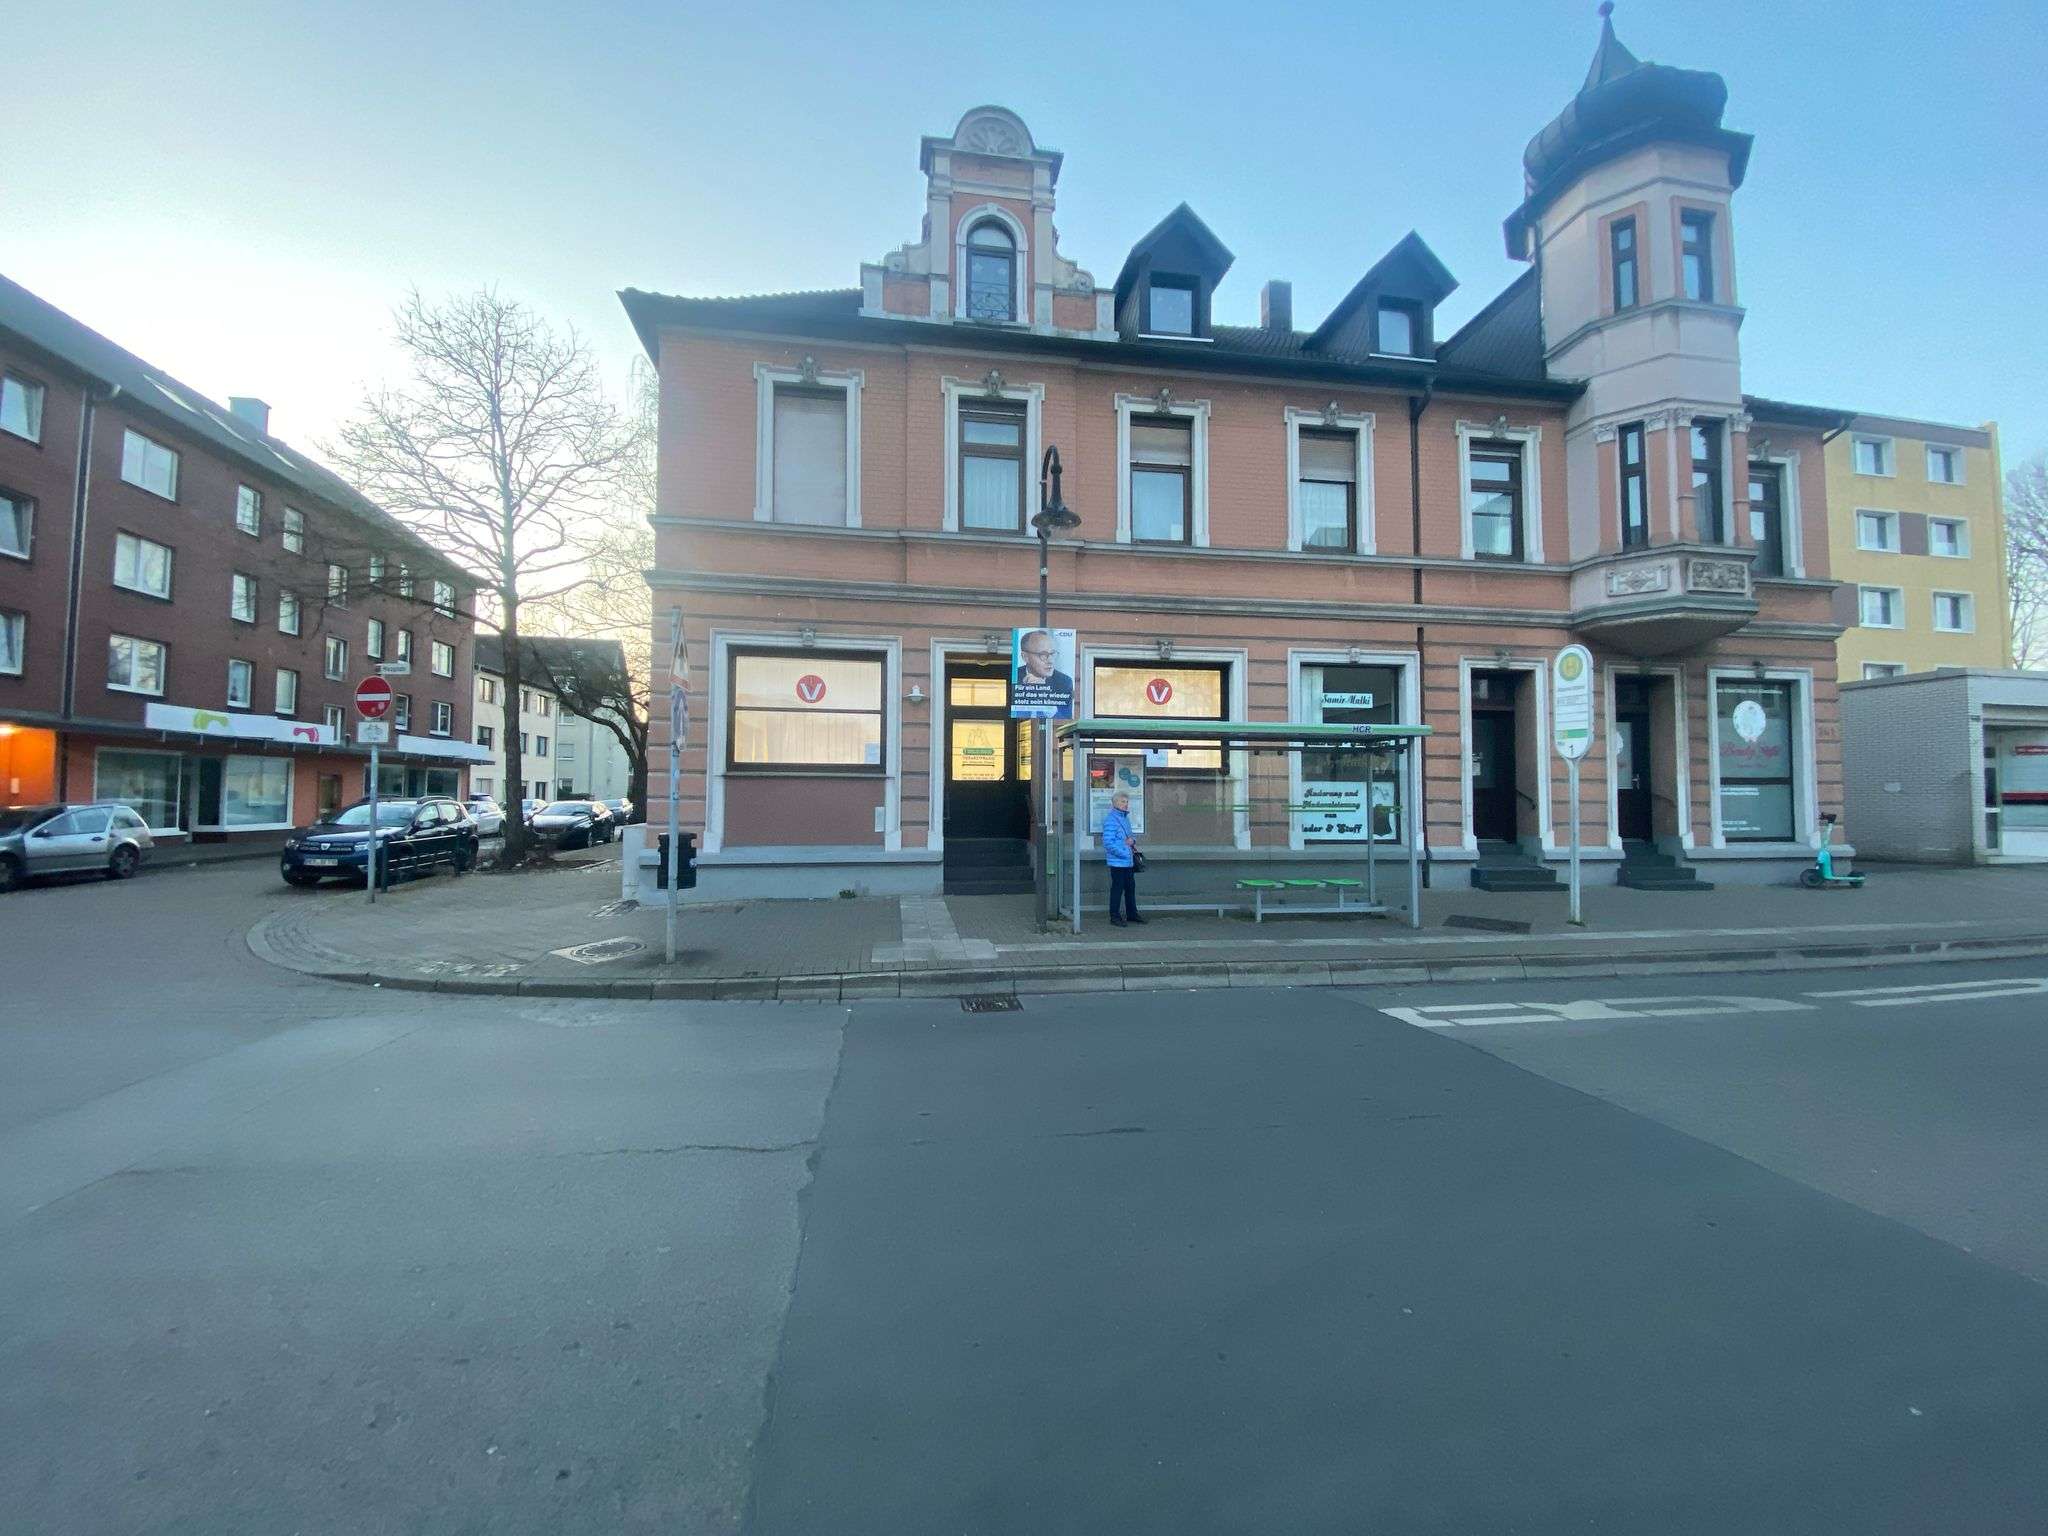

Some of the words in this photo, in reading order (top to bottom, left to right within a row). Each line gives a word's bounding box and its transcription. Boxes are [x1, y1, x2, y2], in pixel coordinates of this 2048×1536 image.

[1035, 684, 1053, 692] Land,
[1321, 694, 1346, 704] Samir
[1352, 725, 1372, 733] HCR
